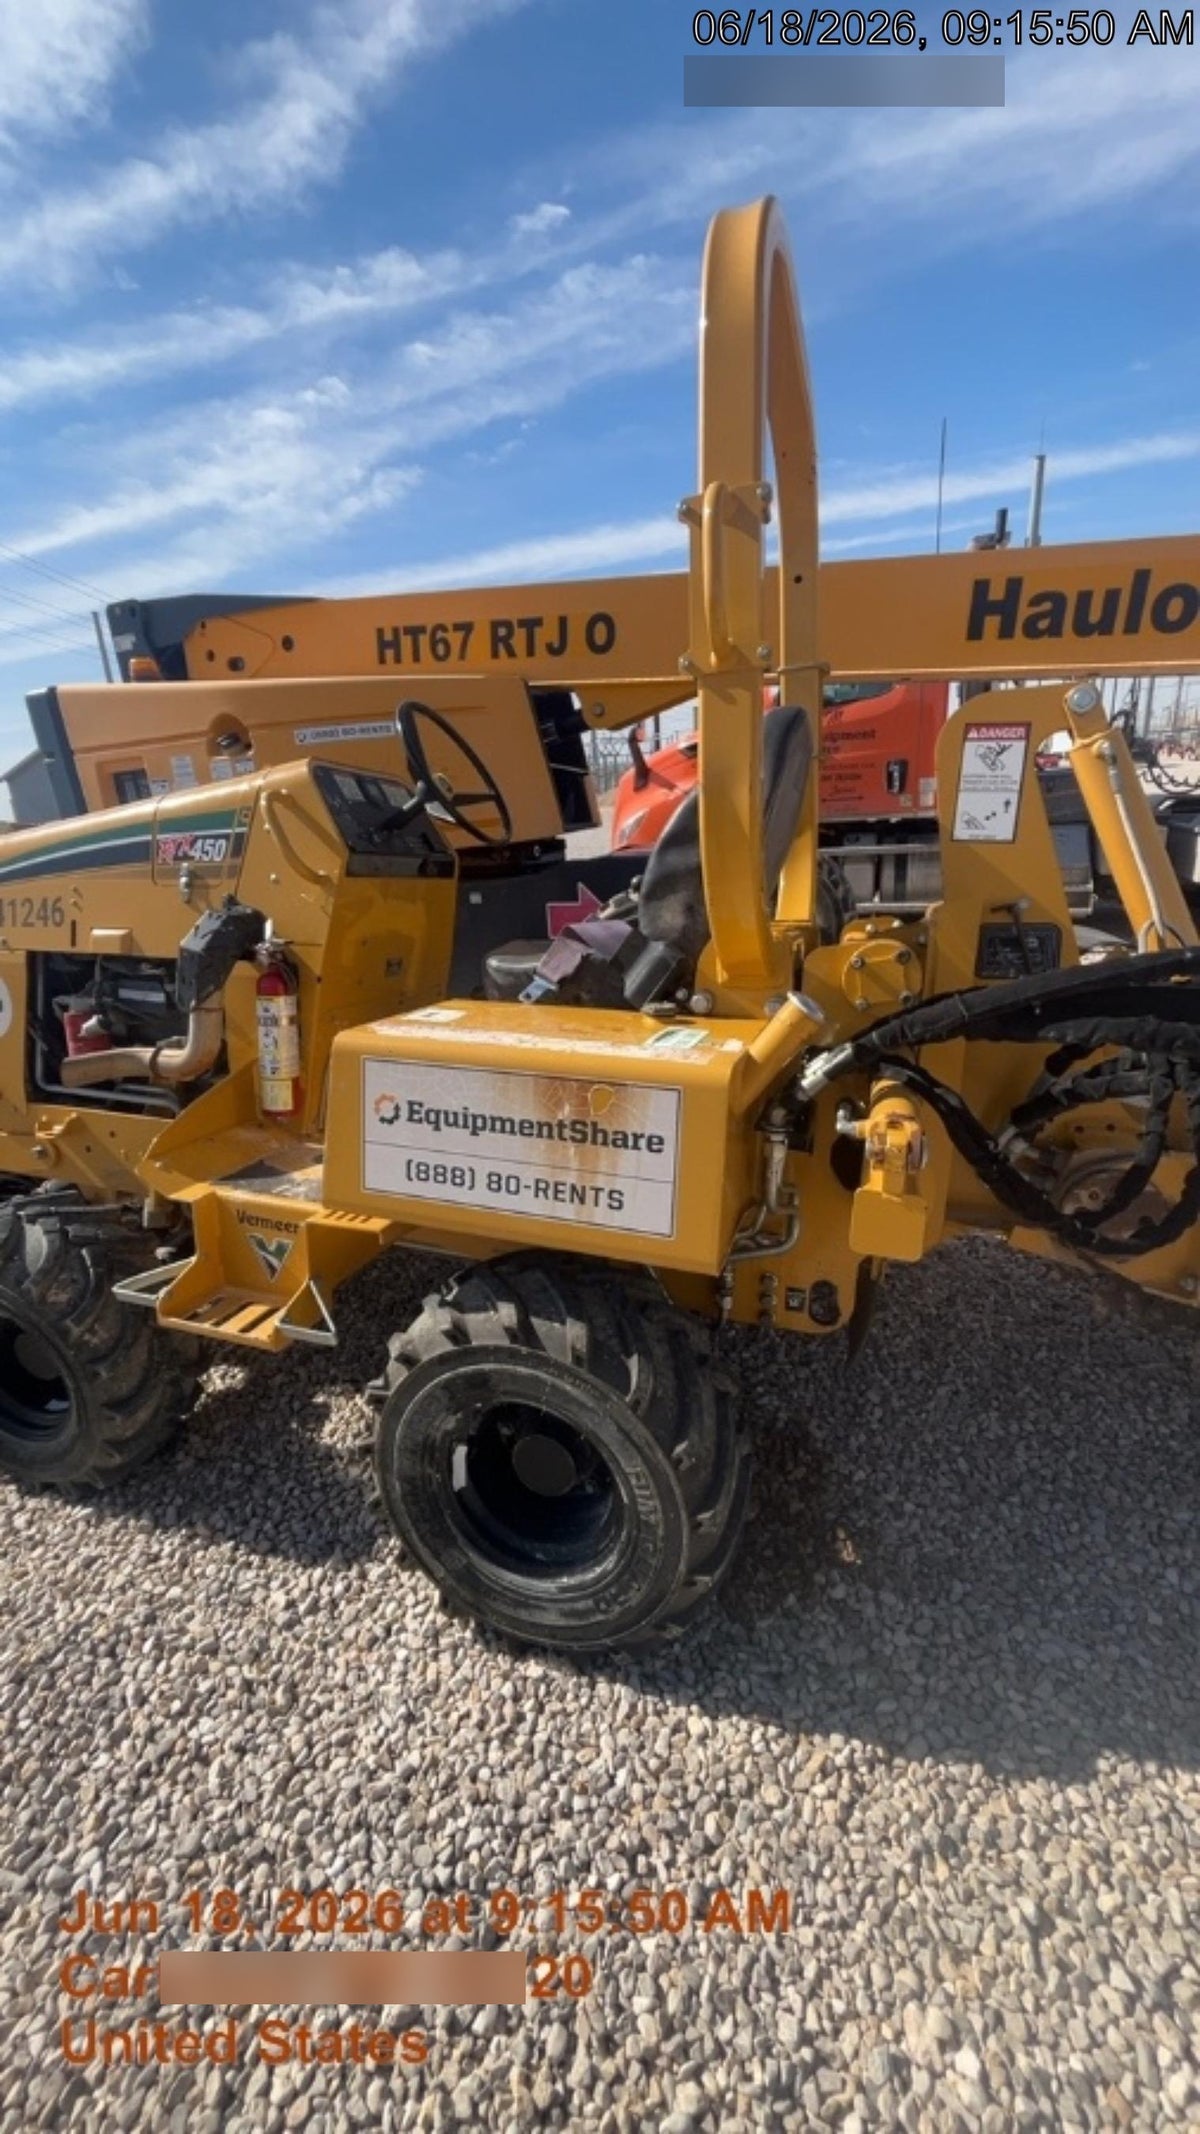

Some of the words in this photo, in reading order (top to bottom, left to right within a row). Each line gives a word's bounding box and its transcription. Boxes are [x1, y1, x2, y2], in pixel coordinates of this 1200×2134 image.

[376, 621, 474, 665] HT67
[490, 615, 568, 659] RTJ
[585, 612, 616, 655] O
[980, 727, 1026, 739] DANGER
[406, 1100, 665, 1154] EquipmentShare
[405, 1158, 475, 1189] (888)
[486, 1172, 625, 1211] 80-RENTS
[236, 1209, 299, 1235] Vermeer
